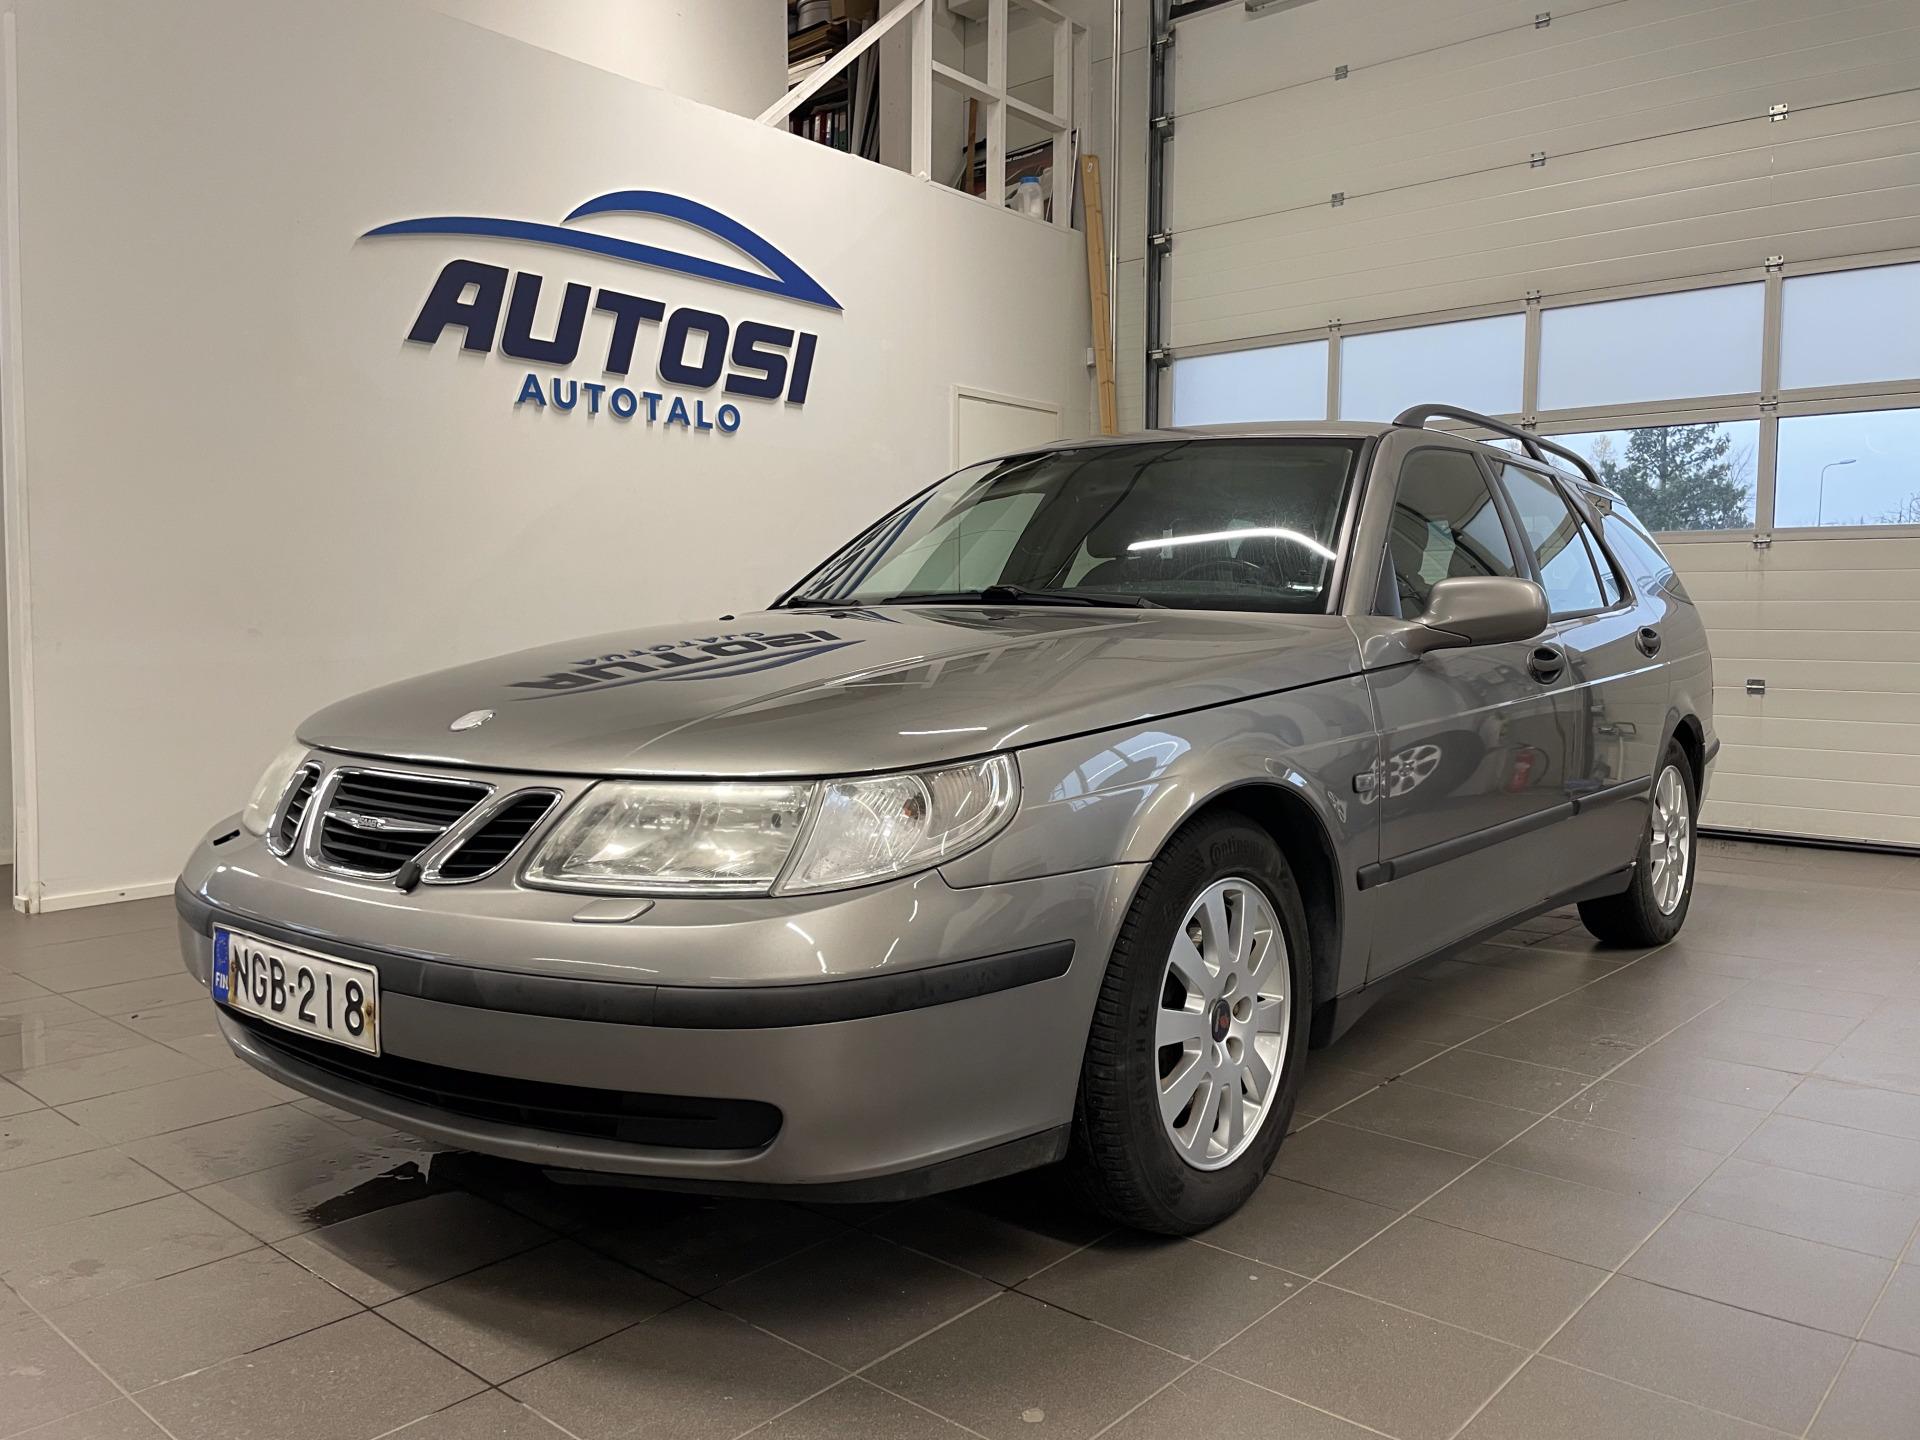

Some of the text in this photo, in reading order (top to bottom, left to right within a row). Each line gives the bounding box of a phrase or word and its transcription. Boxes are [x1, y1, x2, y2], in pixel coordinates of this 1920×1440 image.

[406, 259, 819, 405] AUTOSI
[516, 373, 741, 434] AUTOTALO
[358, 817, 377, 828] SAAB
[215, 971, 229, 991] FIN
[233, 944, 365, 1037] NGB-218
